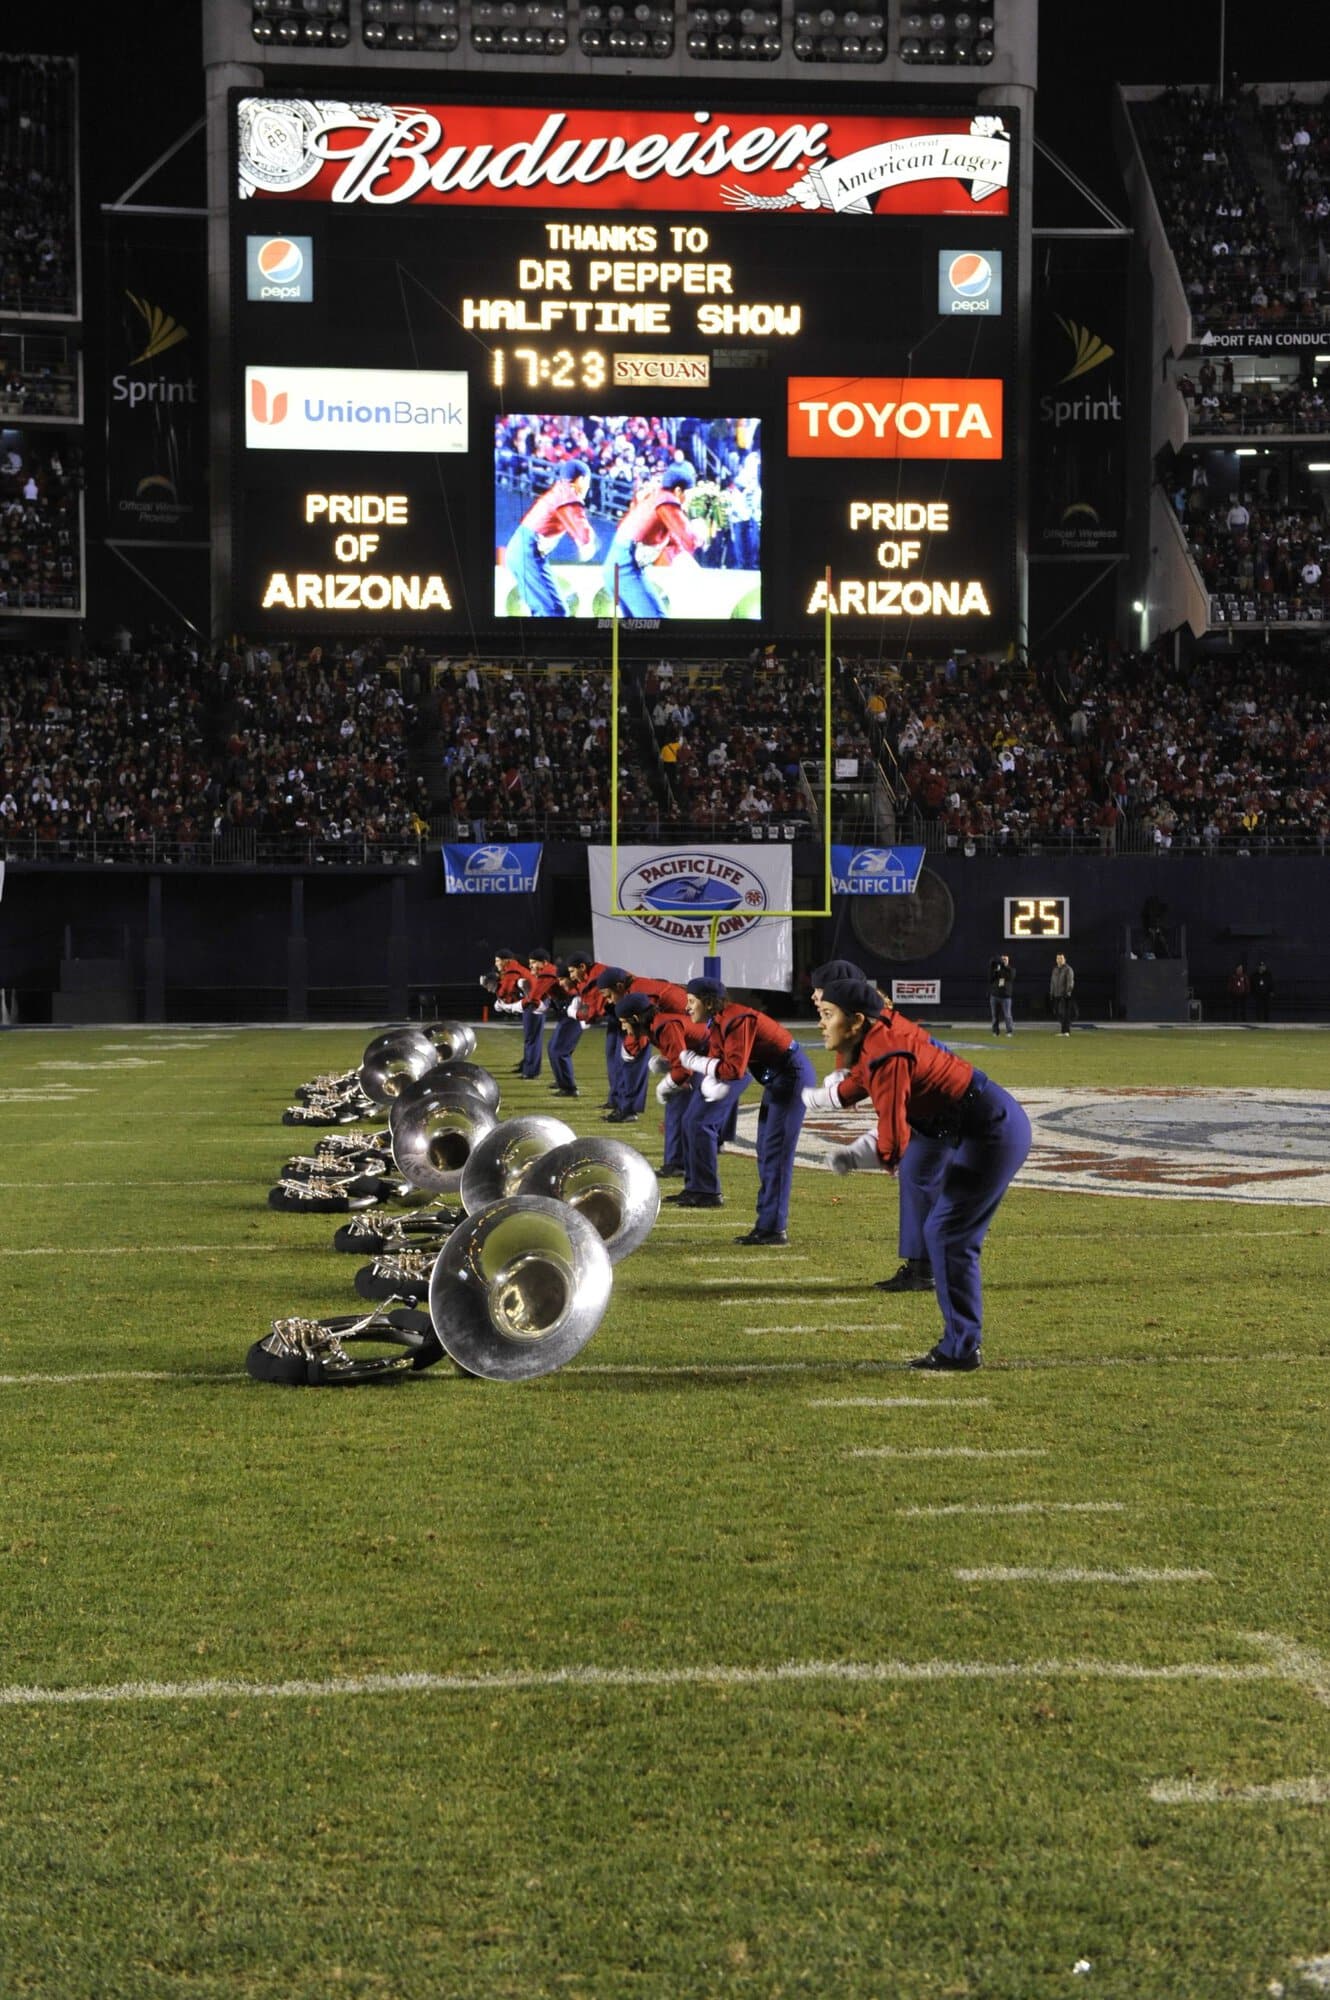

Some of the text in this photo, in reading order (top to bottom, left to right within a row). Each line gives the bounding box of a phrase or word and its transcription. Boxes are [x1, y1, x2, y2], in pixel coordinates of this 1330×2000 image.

[308, 111, 829, 204] Budweiser
[837, 148, 1003, 197] American Lager
[545, 223, 709, 253] THANKS TO
[261, 284, 301, 299] pepsi
[519, 260, 734, 295] DR PEPPER
[463, 299, 802, 336] HALFTIME SHOW
[951, 298, 990, 313] pepsi
[1209, 332, 1330, 346] PORT FAN CONDUC
[492, 348, 607, 389] 17:23
[616, 359, 709, 380] SYCUAN
[112, 375, 198, 408] Sprint
[304, 399, 464, 426] UnionBank
[799, 401, 993, 439] TOYOTA
[1040, 393, 1122, 428] Sprint
[305, 493, 409, 525] PRIDE
[849, 501, 950, 532] PRIDE
[335, 533, 381, 563] OF
[877, 540, 921, 569] OF
[262, 573, 453, 611] ARIZONA
[807, 580, 992, 617] ARIZONA
[508, 875, 535, 892] LIF
[638, 858, 745, 886] PACIFIC LIFE
[892, 876, 915, 893] LIF
[1014, 900, 1060, 935] 25
[896, 983, 937, 994] ESPN
